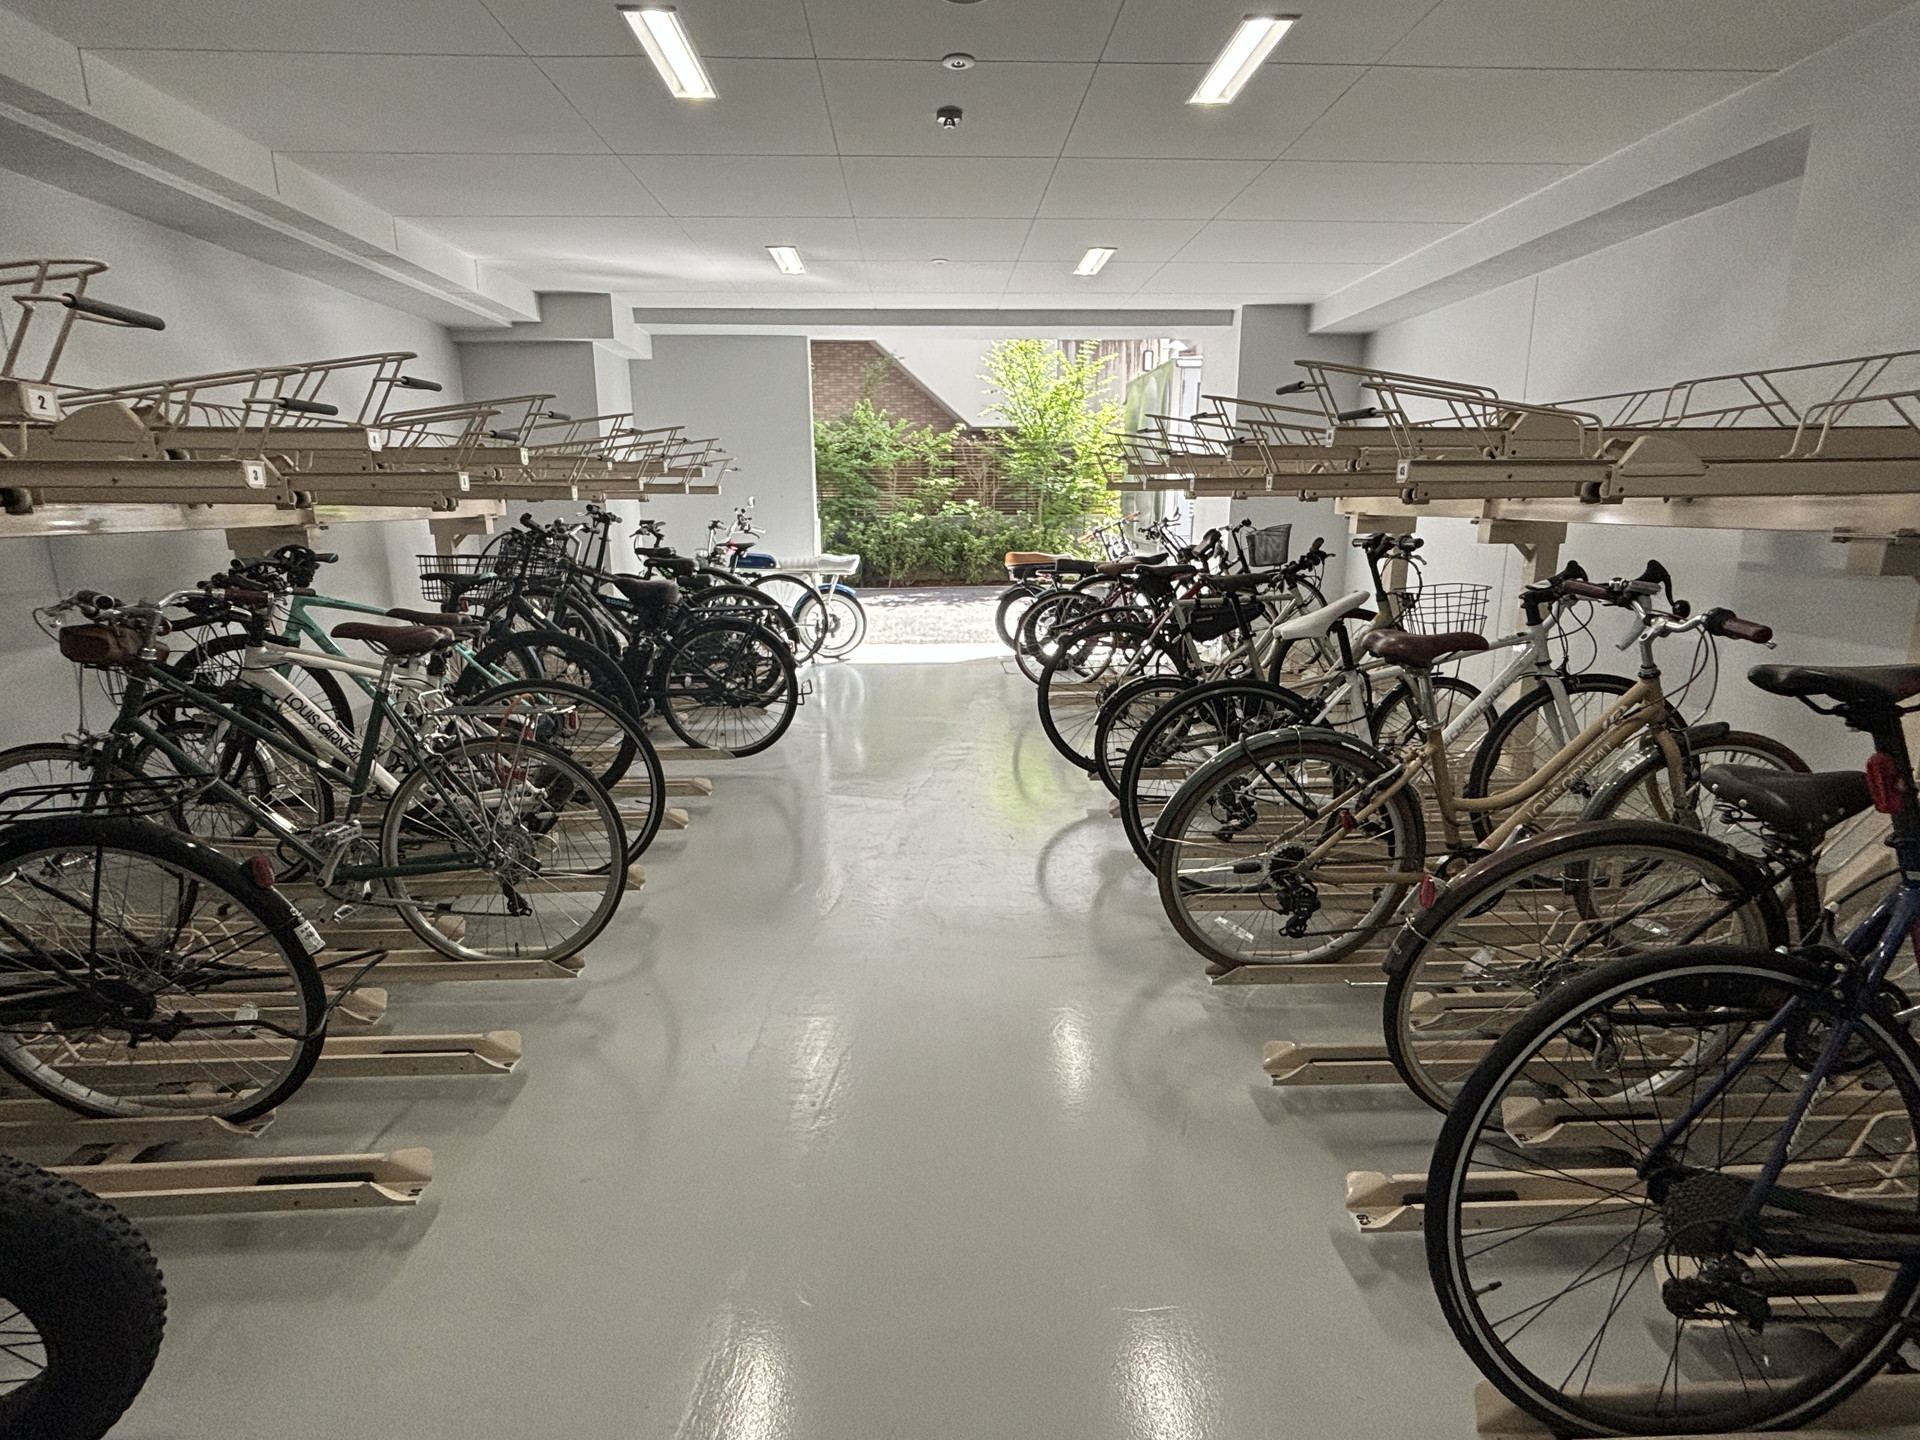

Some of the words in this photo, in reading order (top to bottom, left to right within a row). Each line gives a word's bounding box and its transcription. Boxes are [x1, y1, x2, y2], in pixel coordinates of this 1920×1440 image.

[37, 395, 47, 409] 2
[252, 469, 258, 481] 3
[284, 692, 320, 726] LOUIS
[1527, 787, 1561, 819] LOUIS
[1356, 1214, 1371, 1226] 63
